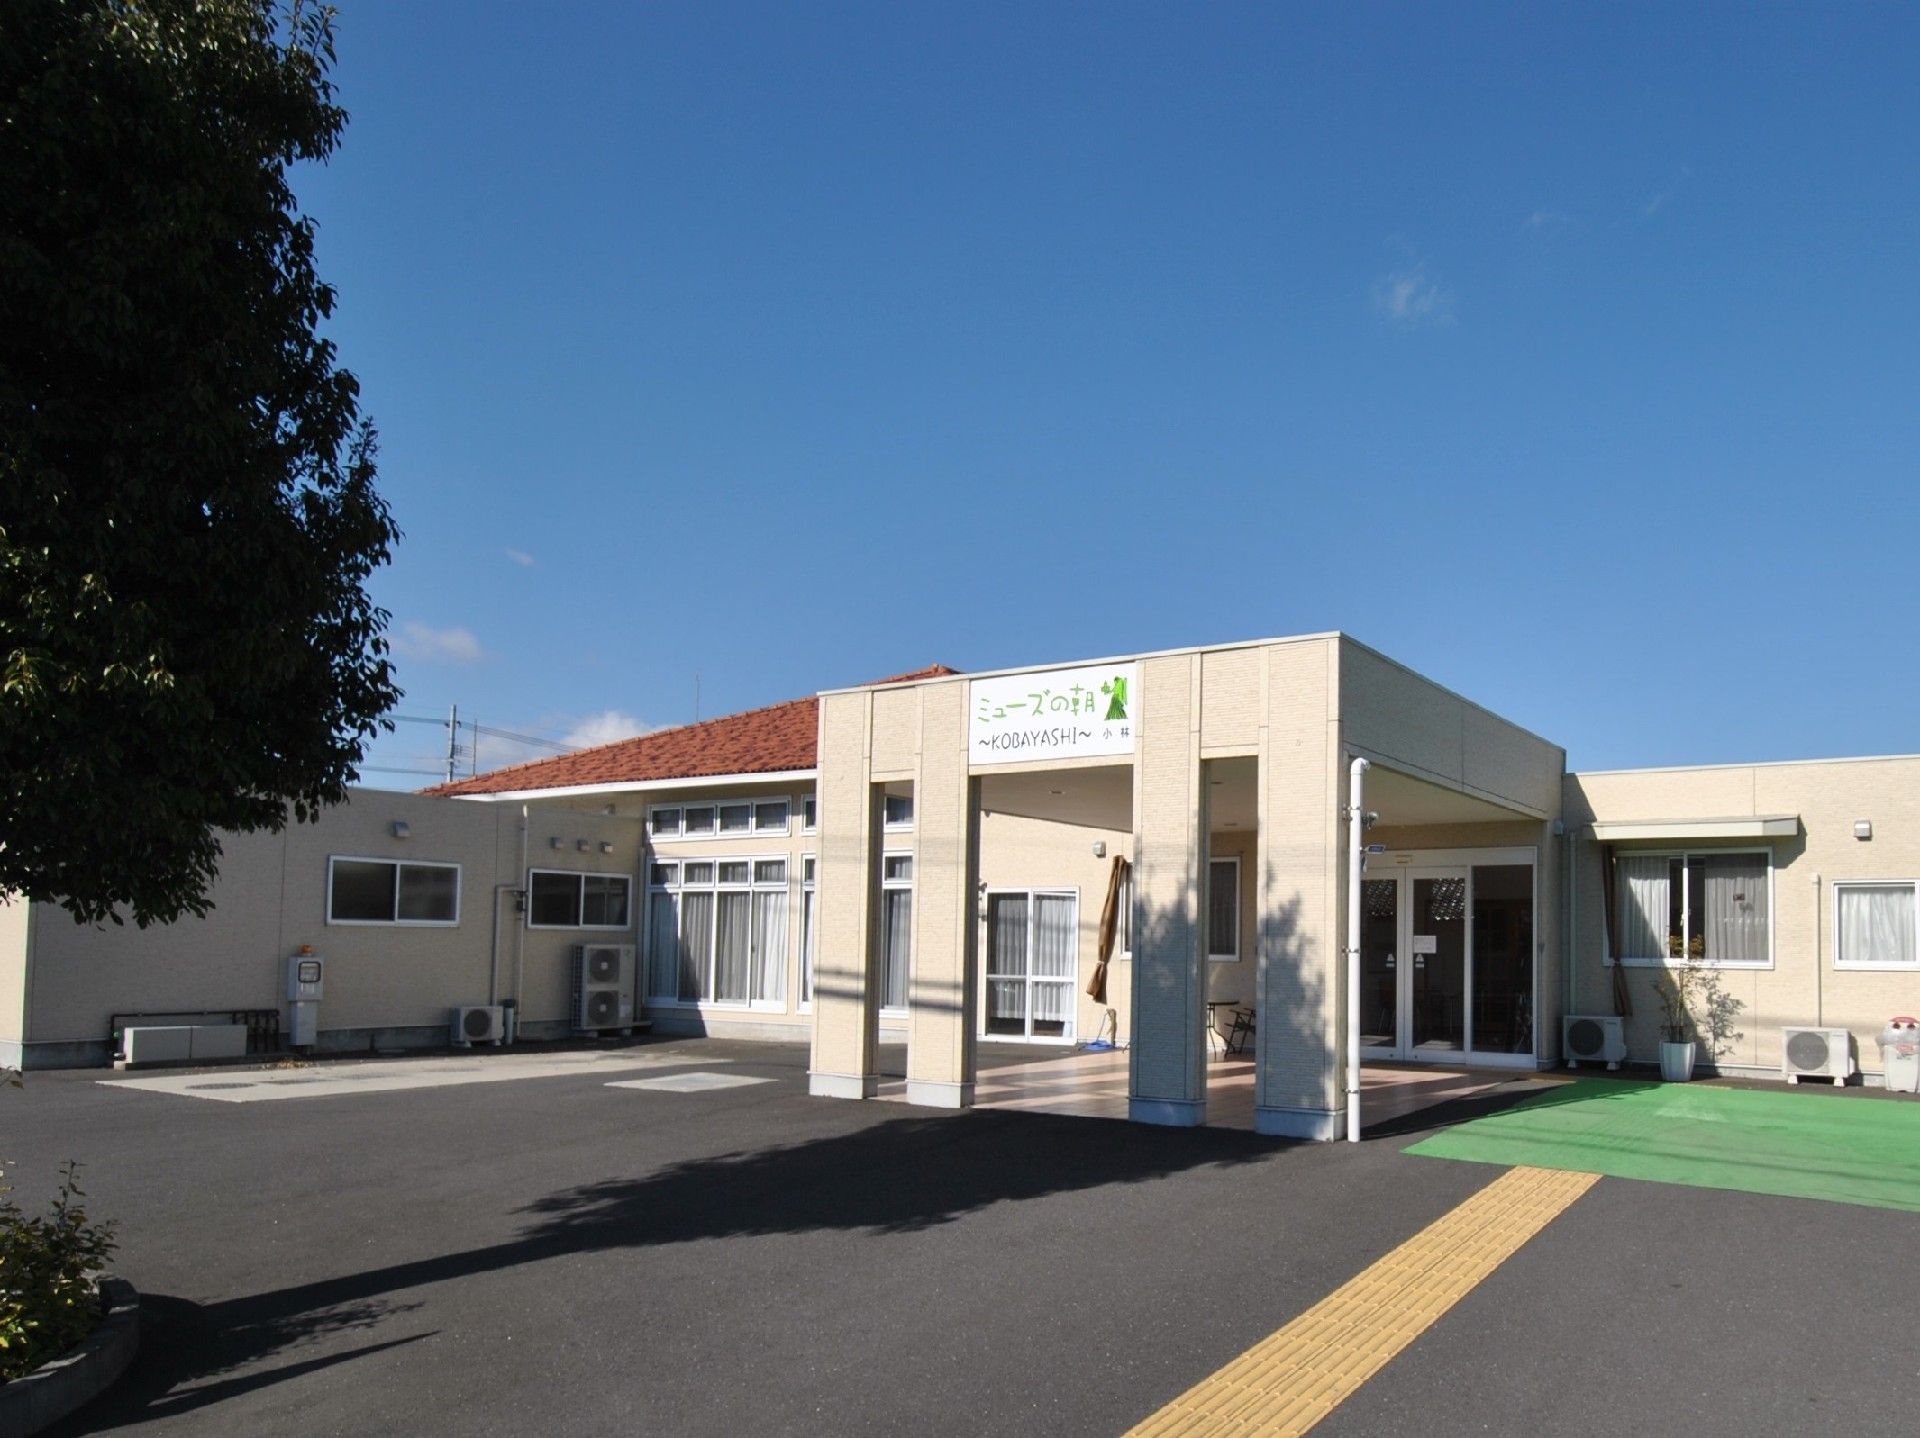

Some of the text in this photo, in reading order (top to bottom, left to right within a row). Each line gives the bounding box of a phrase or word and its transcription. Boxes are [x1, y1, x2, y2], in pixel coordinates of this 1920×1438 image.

[978, 683, 1095, 722] ミューズの朝
